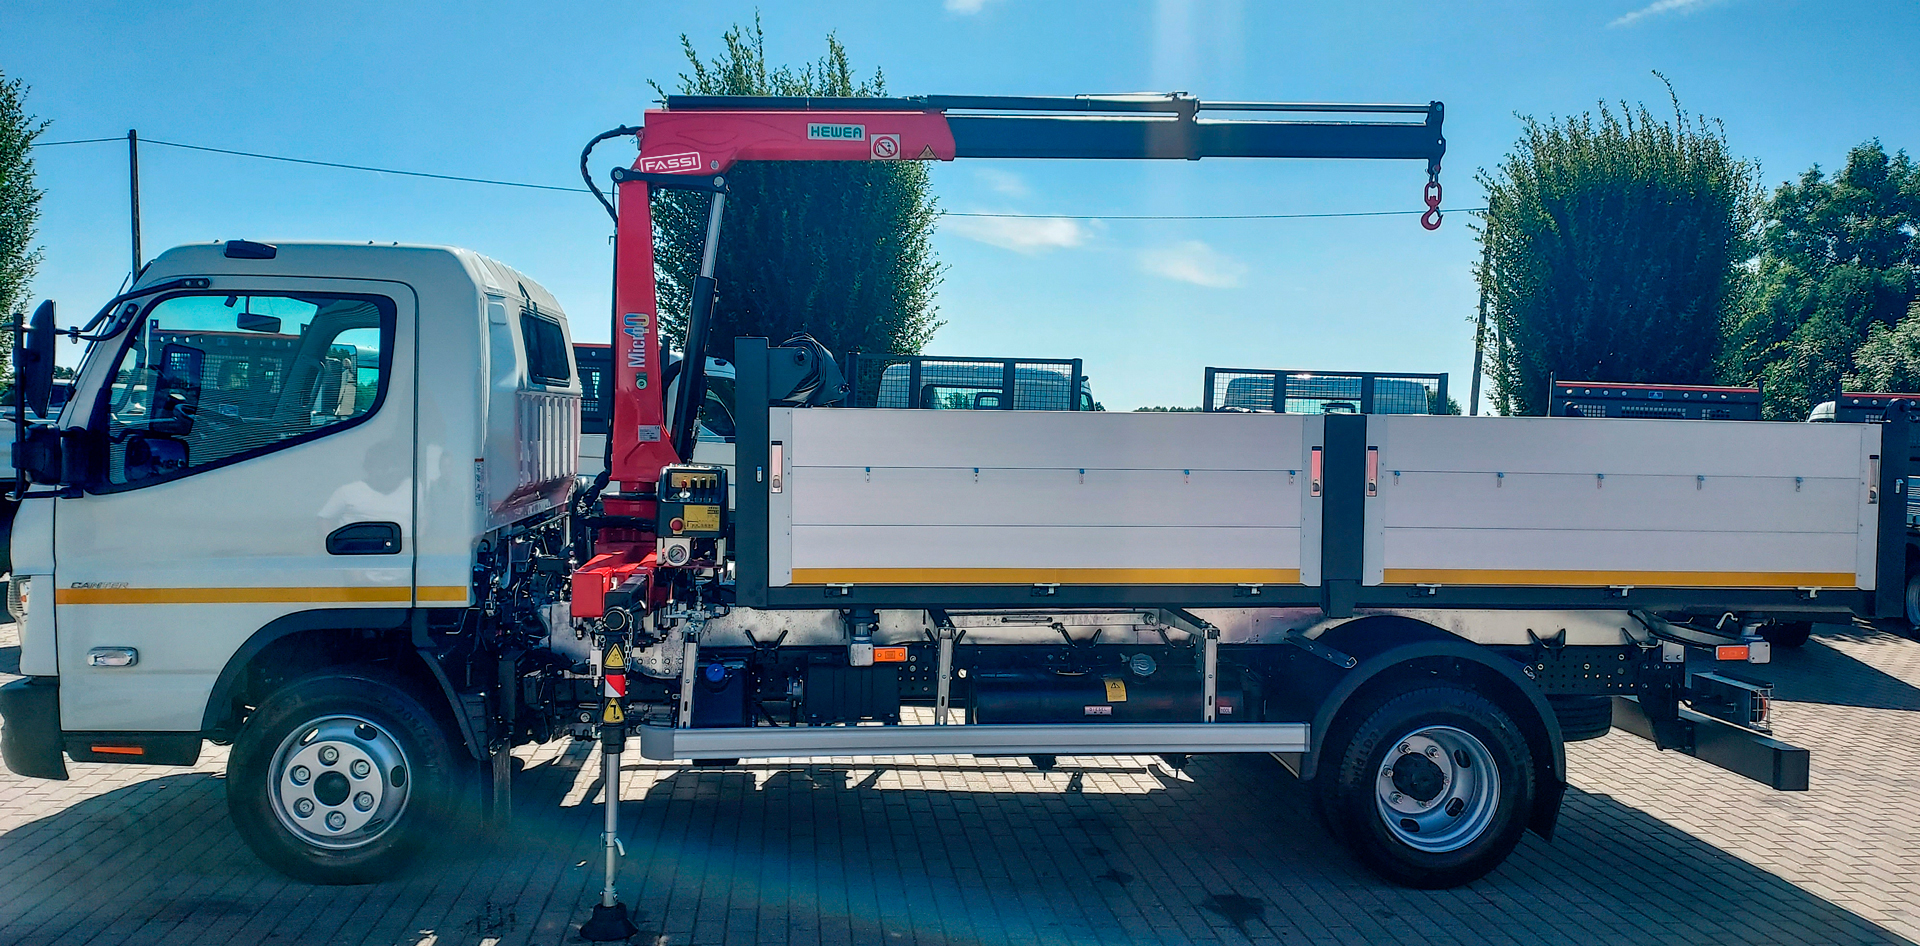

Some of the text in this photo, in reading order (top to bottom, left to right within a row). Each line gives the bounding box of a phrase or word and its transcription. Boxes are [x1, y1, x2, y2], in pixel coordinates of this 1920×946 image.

[810, 125, 863, 139] HEWEA
[644, 156, 698, 172] FASSI
[70, 581, 129, 589] CANTER
